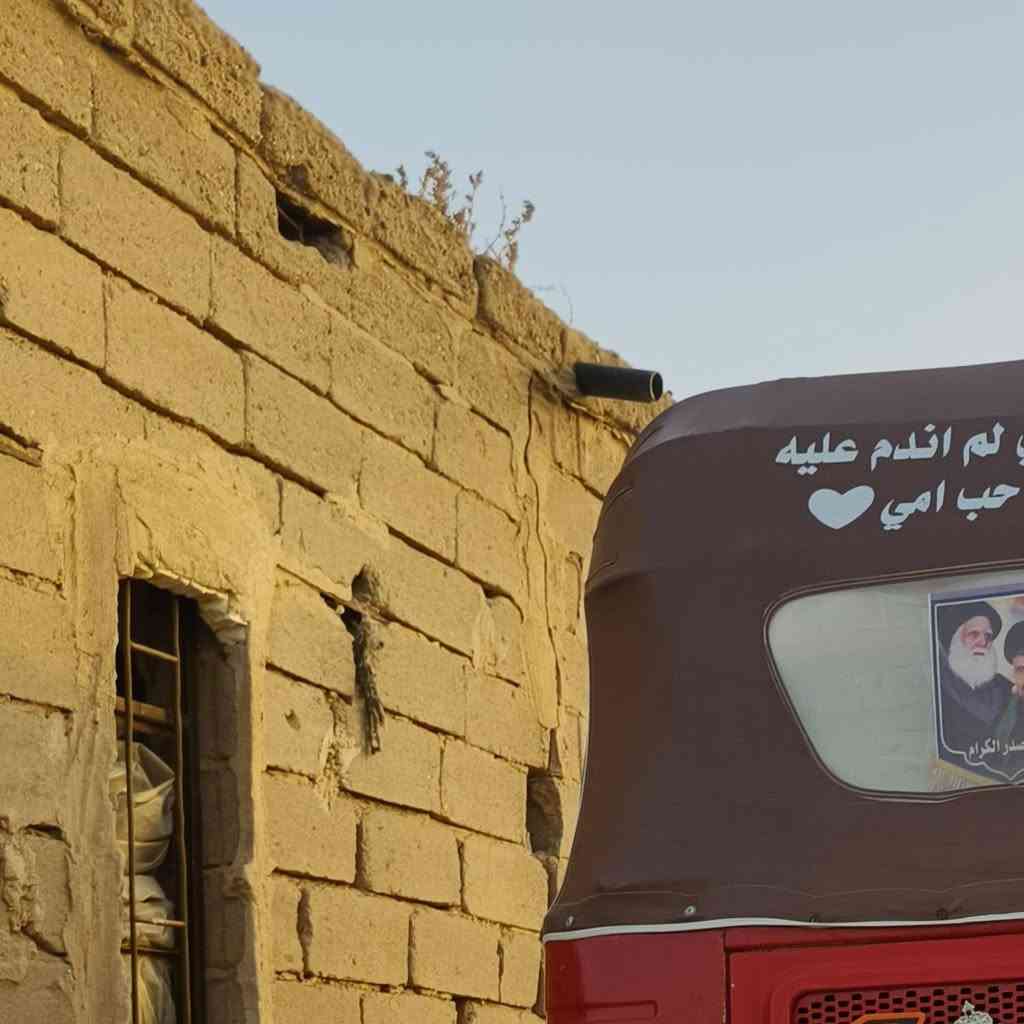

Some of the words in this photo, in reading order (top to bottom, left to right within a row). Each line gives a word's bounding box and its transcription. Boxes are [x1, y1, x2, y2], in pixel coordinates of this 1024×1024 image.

[775, 431, 859, 476] عليه
[870, 423, 952, 471] اندم
[963, 422, 1005, 467] لم
[880, 479, 946, 531] امي
[956, 483, 1021, 521] حب
[968, 737, 1000, 760] الكرام
